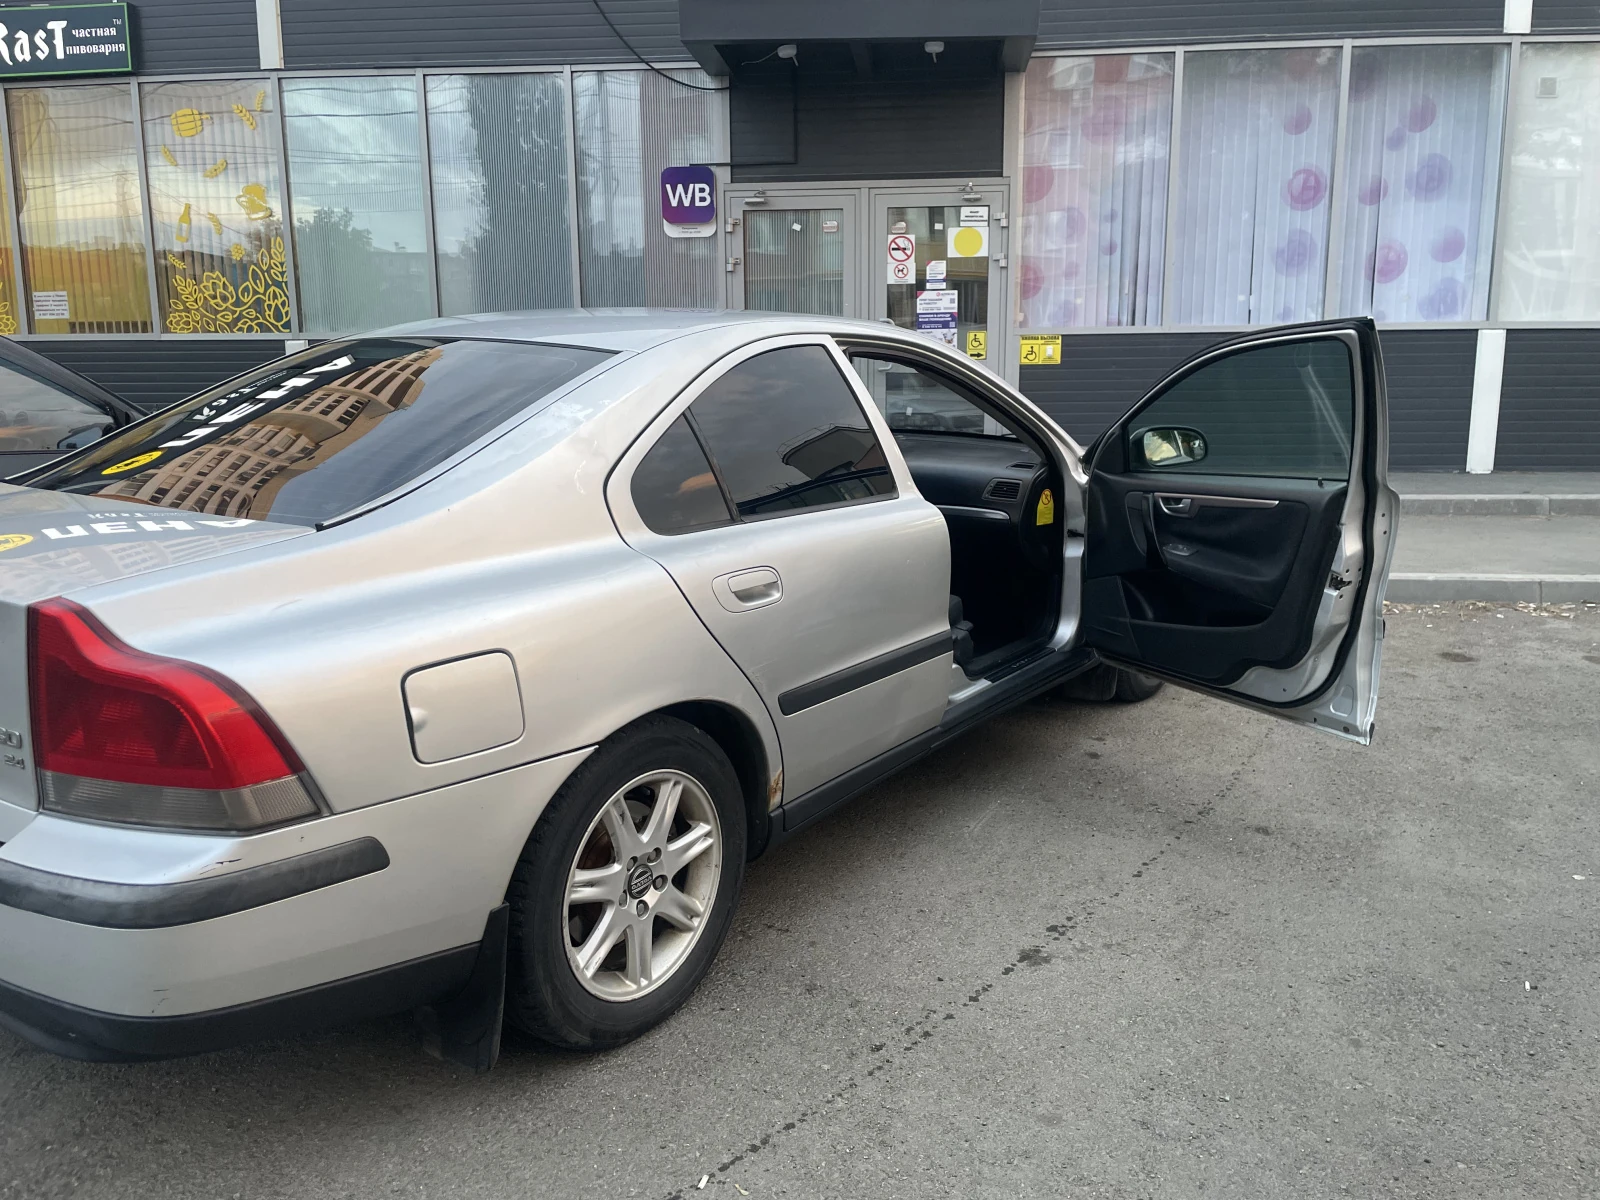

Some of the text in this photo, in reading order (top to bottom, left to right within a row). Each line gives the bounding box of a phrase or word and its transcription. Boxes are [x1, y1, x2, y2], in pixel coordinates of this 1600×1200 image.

[71, 27, 117, 38] частная
[65, 43, 126, 56] пивоварня
[665, 183, 711, 207] WB
